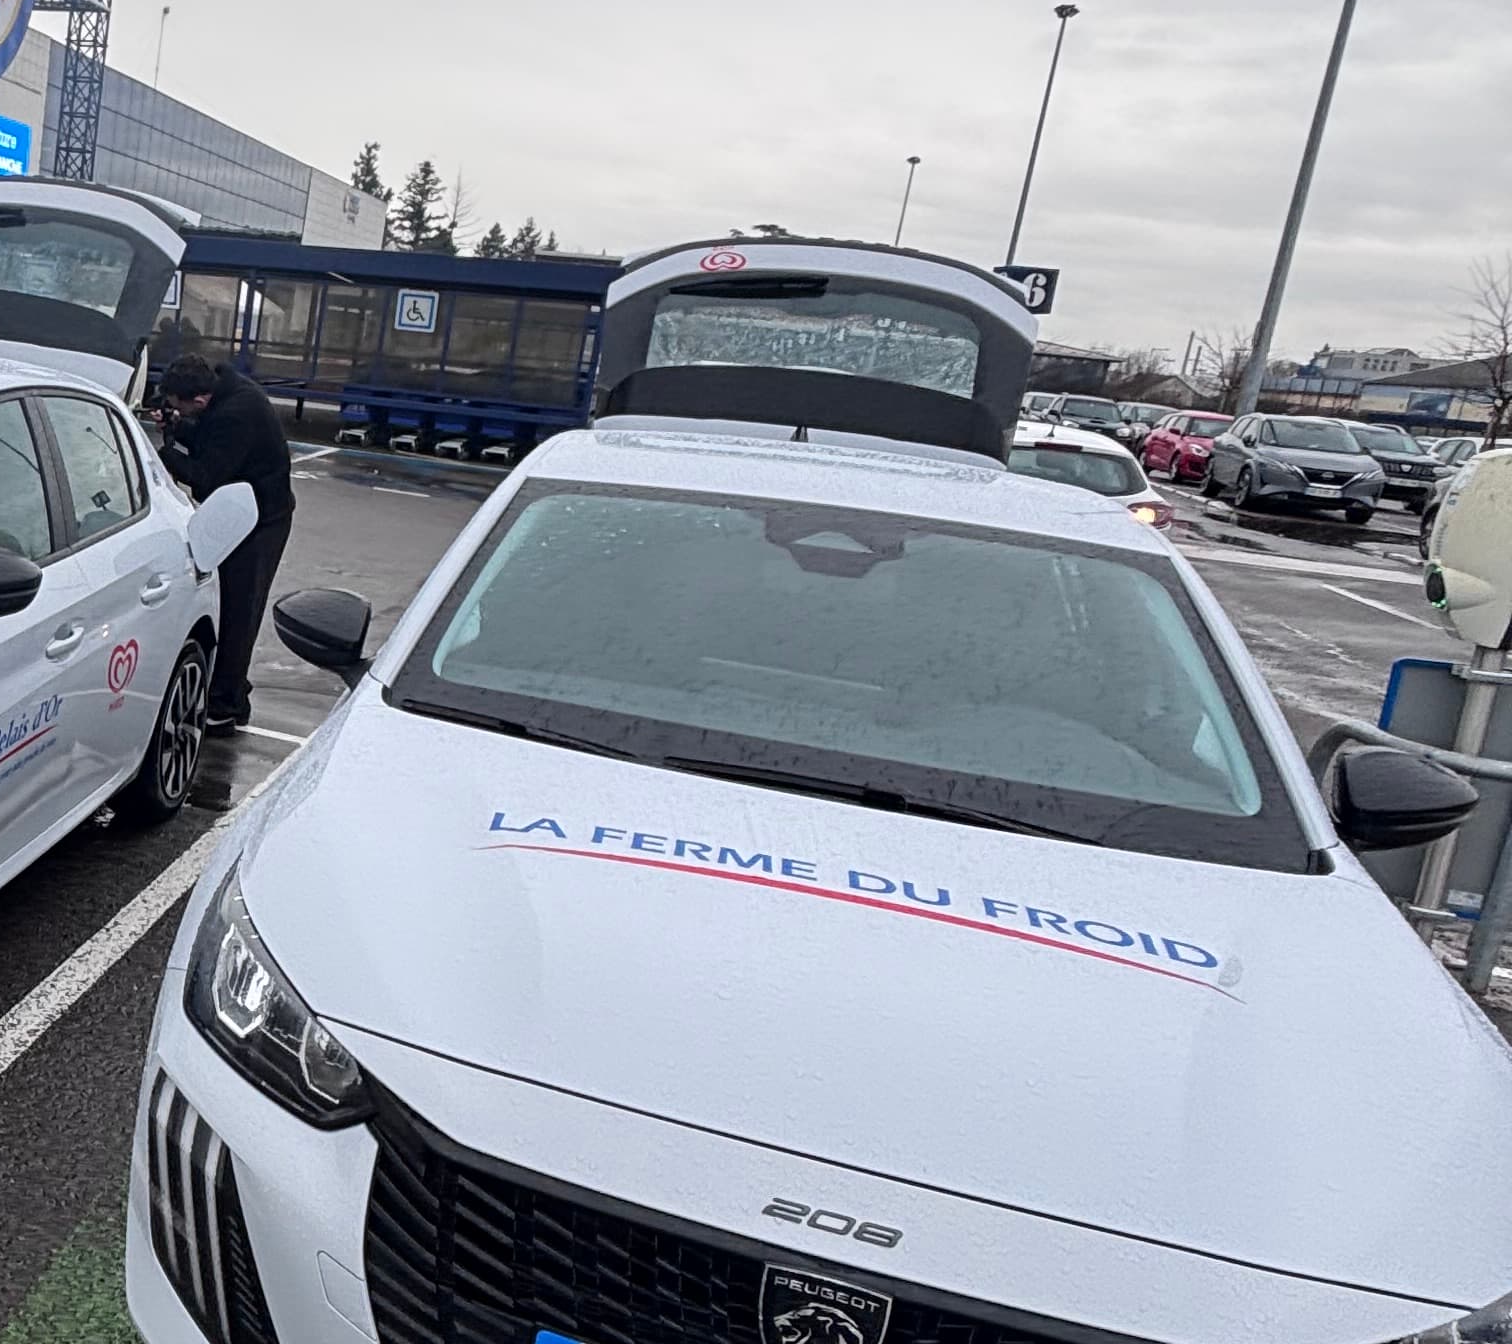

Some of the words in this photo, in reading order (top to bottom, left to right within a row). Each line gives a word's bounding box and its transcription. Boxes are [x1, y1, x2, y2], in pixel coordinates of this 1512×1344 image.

[32, 693, 64, 732] d'Or
[488, 811, 567, 839] LA
[590, 826, 818, 881] FERME
[847, 869, 953, 908] DU
[979, 897, 1219, 969] FROID
[761, 1197, 904, 1249] 208
[773, 1276, 881, 1314] PEUGEOT
